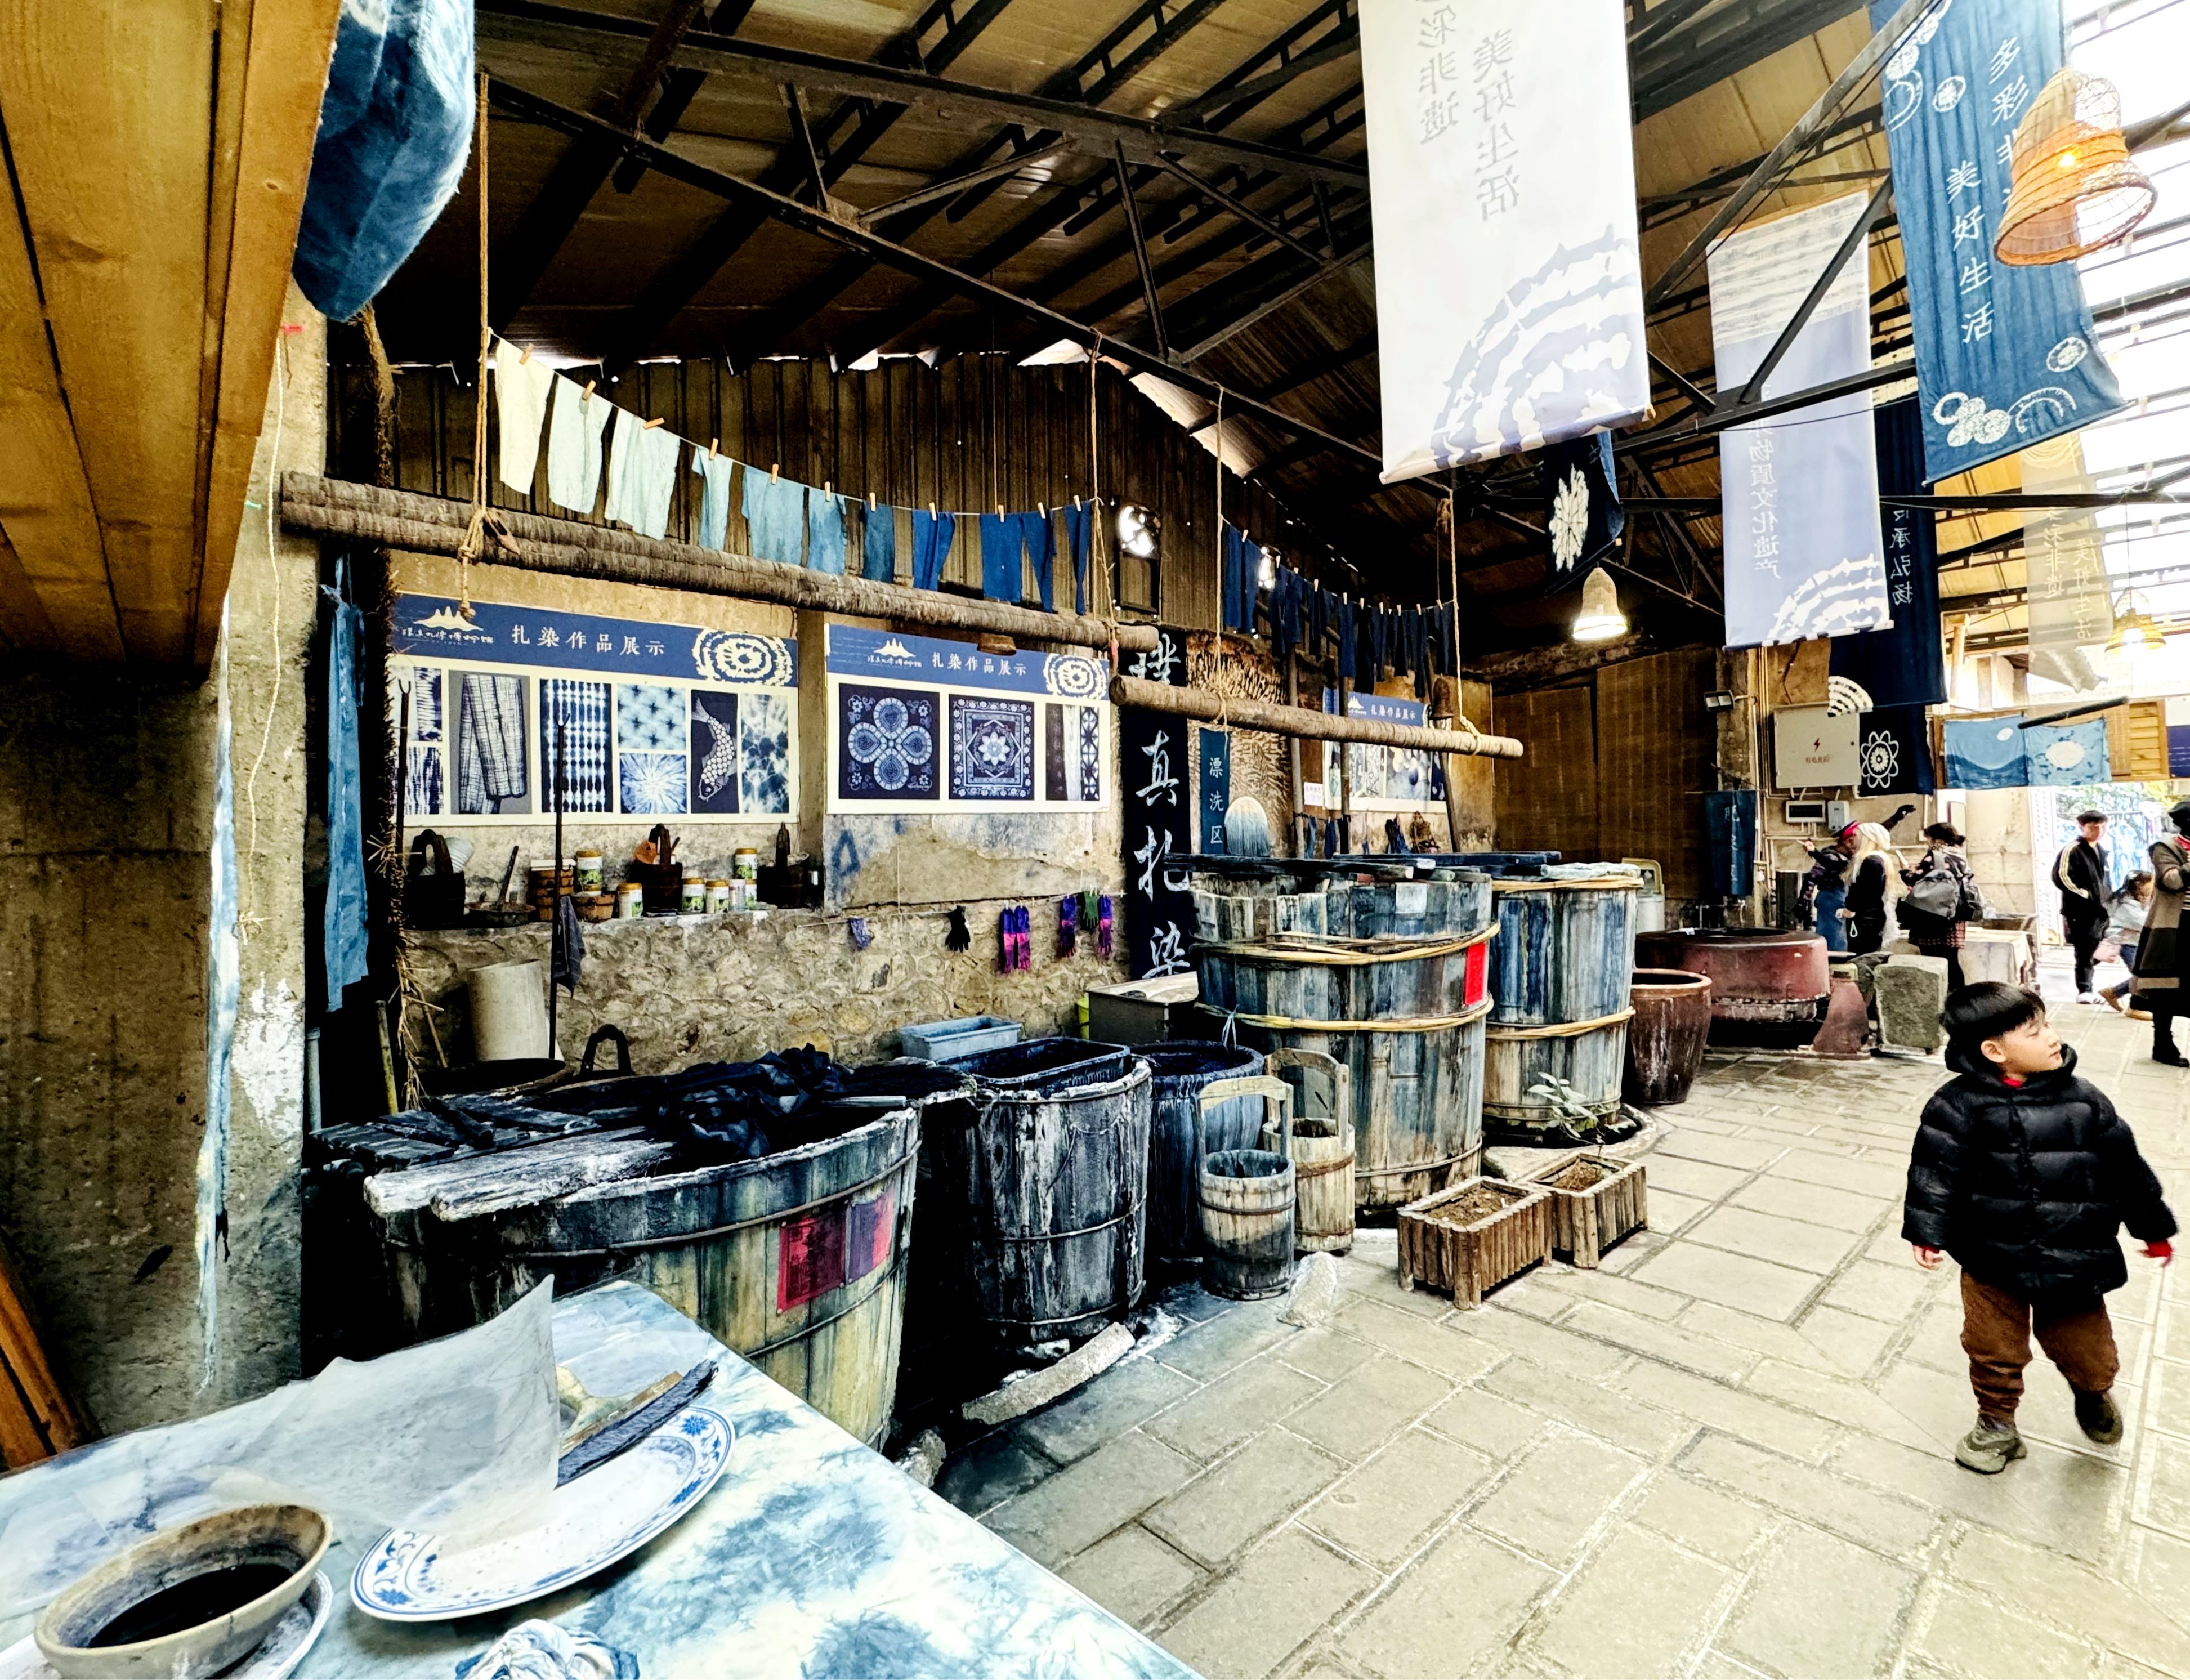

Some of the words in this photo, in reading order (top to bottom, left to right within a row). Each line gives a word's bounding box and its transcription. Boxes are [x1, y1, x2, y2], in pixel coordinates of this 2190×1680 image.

[1988, 37, 2030, 205] 多彩
[1946, 160, 1995, 344] 美好生活
[511, 623, 666, 656] 扎染作品展示
[932, 651, 1027, 676] 扎染作品展示
[1209, 757, 1224, 844] 漂洗区
